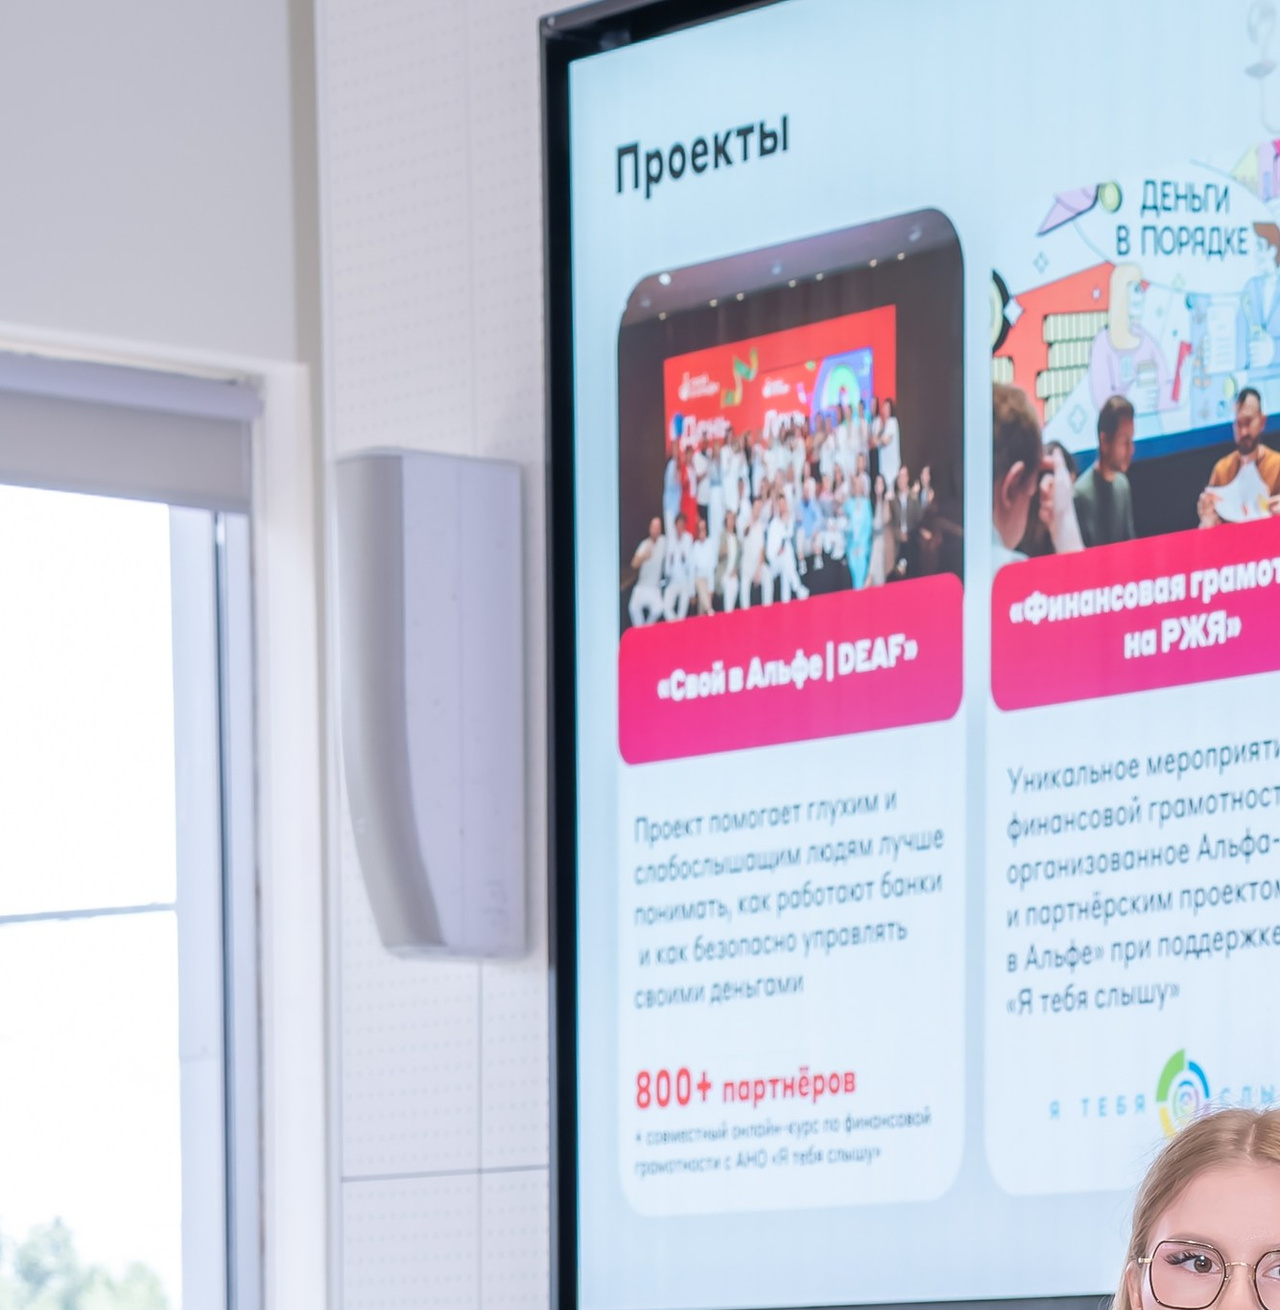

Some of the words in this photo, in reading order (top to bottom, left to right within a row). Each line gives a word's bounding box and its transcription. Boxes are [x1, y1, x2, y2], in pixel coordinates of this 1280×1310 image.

[616, 115, 789, 199] Проекты
[1141, 179, 1230, 217] ДЕНЬГИ
[1116, 226, 1130, 256] В
[1141, 225, 1249, 261] ПОРЯДКЕ
[1009, 573, 1186, 625] «Финансовая
[1124, 629, 1157, 659] на
[1161, 610, 1242, 653] РЖЯ»
[657, 661, 725, 701] «Свой
[729, 666, 744, 692] в
[747, 648, 823, 689] Альфе
[1006, 756, 1140, 795] Уникальное
[635, 814, 702, 846] Проект
[709, 803, 801, 834] помогает
[807, 794, 878, 825] глухим
[885, 792, 897, 811] и
[1007, 796, 1142, 847] финансовой
[635, 846, 801, 885] слабослышащим
[806, 836, 873, 865] людям
[879, 827, 944, 859] лучше
[1007, 842, 1189, 891] организованное
[635, 898, 733, 927] понимать,
[738, 892, 771, 914] как
[776, 882, 874, 917] работают
[880, 871, 943, 898] банки
[1007, 907, 1020, 928] и
[1025, 890, 1172, 933] партнёрским
[639, 946, 650, 967] и
[656, 942, 689, 964] как
[694, 933, 797, 961] безопасно
[802, 919, 908, 957] управлять
[1007, 951, 1017, 973] в
[1024, 939, 1104, 974] Альфе»
[1110, 937, 1152, 968] при
[634, 983, 705, 1009] своими
[710, 973, 804, 1006] деньгами
[1007, 988, 1033, 1017] «Я
[1041, 984, 1088, 1014] тебя
[1095, 983, 1180, 1017] слышу»
[636, 1067, 711, 1109] 800+
[723, 1066, 856, 1107] партнёров
[1082, 1094, 1146, 1117] ТЕБЯ
[736, 1149, 767, 1169] АНО
